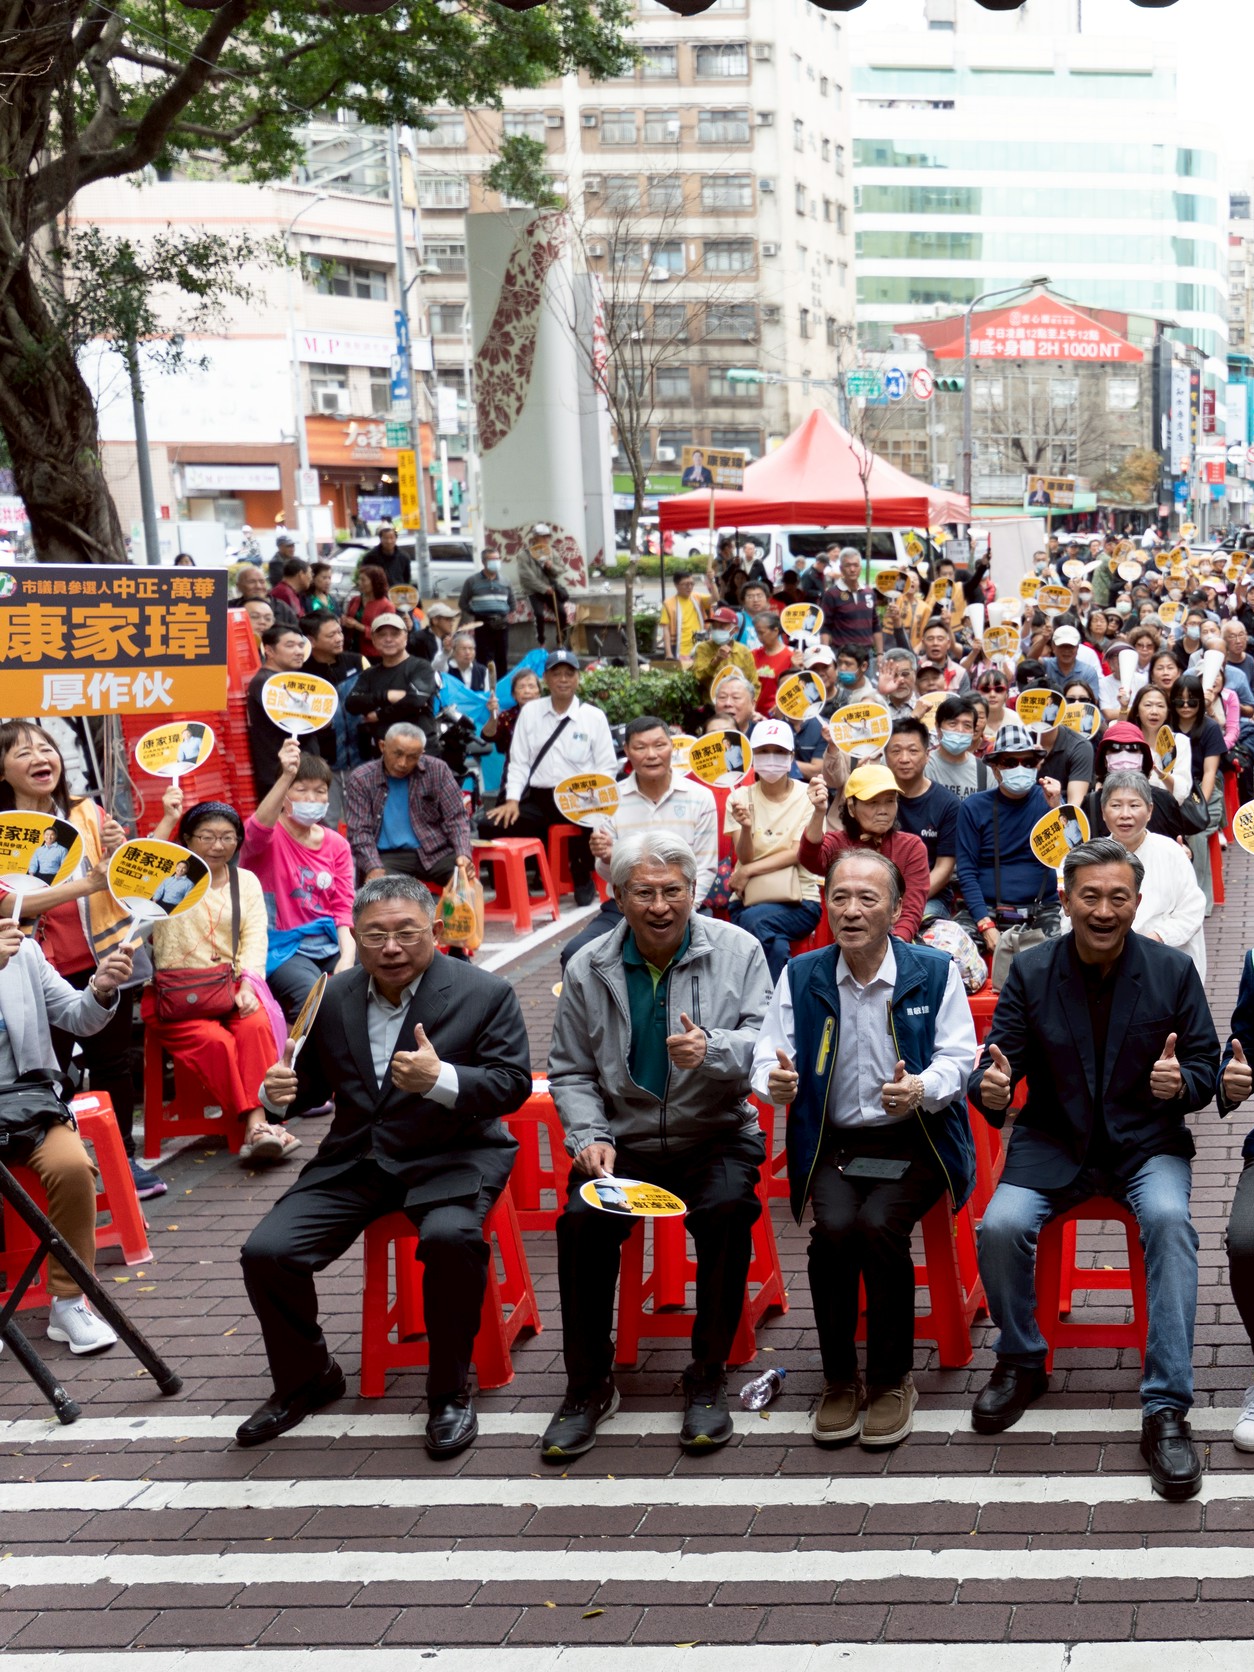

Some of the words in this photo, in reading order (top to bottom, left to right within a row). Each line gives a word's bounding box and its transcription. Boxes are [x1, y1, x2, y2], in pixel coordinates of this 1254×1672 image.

[1038, 343, 1058, 356] 2H
[1063, 343, 1097, 357] 1000
[1100, 343, 1121, 357] NT
[22, 580, 111, 595] 市議員參選人
[0, 603, 211, 662] 康家瑋
[40, 670, 175, 711] 厚作伙
[1063, 711, 1080, 719] 家瑋
[142, 733, 181, 750] 康家瑋
[692, 743, 723, 760] 康家瑋
[0, 825, 41, 844] 家瑋
[1033, 821, 1061, 846] 康家瑋
[122, 846, 174, 873] 康家瑋
